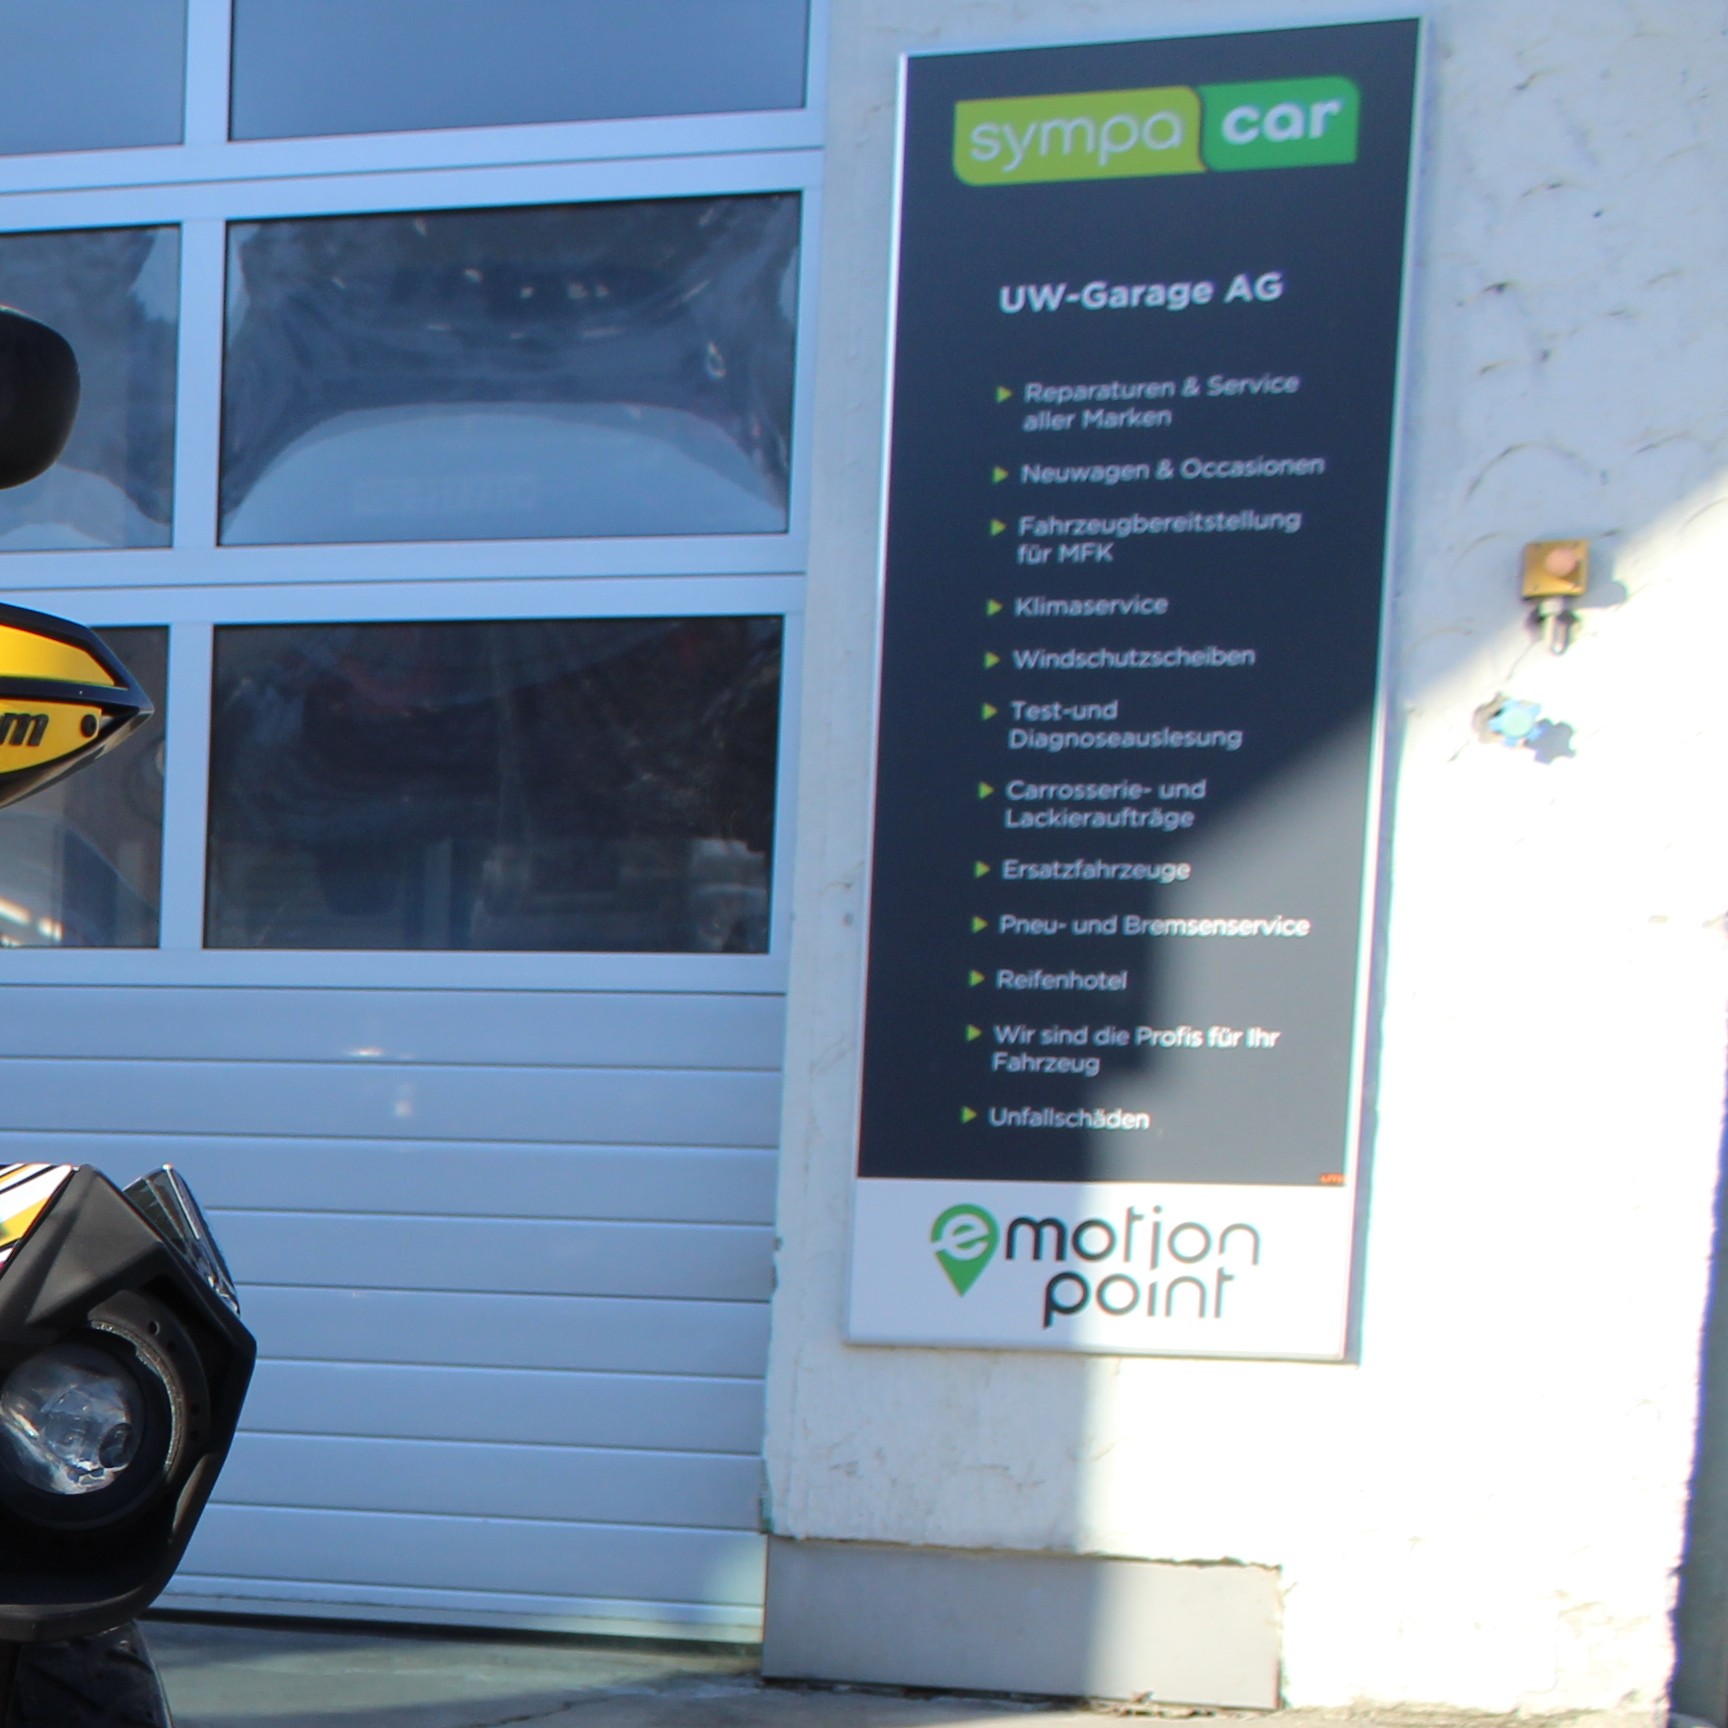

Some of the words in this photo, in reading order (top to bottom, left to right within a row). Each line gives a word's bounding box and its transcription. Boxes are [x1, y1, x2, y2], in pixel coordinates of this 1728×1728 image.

[970, 110, 1183, 172] sympa
[1221, 97, 1341, 145] car
[1000, 279, 1214, 314] UW-Garage
[1224, 273, 1284, 303] AG
[1024, 376, 1175, 406] Reparaturen
[1181, 376, 1200, 397] &
[1207, 373, 1300, 396] Service
[1023, 409, 1077, 432] aller
[1082, 407, 1172, 430] Marken
[1021, 461, 1150, 487] Neuwagen
[1154, 460, 1174, 481] &
[1180, 455, 1325, 481] Occasionen
[1018, 510, 1302, 540] Fahrzeugbereitstellung
[1016, 543, 1052, 564] für
[1057, 543, 1114, 564] MFK
[1014, 596, 1169, 617] Klimaservice
[1013, 645, 1256, 669] Windschutzscheiben
[1008, 725, 1244, 752] Diagnoseauslesung
[1005, 780, 1152, 802] Carrosserie-
[1158, 779, 1207, 799] und
[1004, 806, 1195, 832] Lackieraufträge
[1002, 859, 1192, 885] Ersatzfahrzeuge
[999, 914, 1067, 935] Pneu-
[1071, 914, 1118, 936] und
[1123, 914, 1312, 938] Bremsenservice
[996, 969, 1128, 991] Reifenhotel
[994, 1024, 1035, 1046] Wir
[1039, 1024, 1089, 1046] sind
[1093, 1024, 1131, 1047] die
[1135, 1025, 1204, 1048] Profis
[1208, 1026, 1243, 1048] für
[1247, 1026, 1282, 1048] Ihr
[992, 1052, 1101, 1077] Fahrzeug
[988, 1106, 1150, 1131] Unfallschäden
[1043, 1266, 1235, 1330] point
